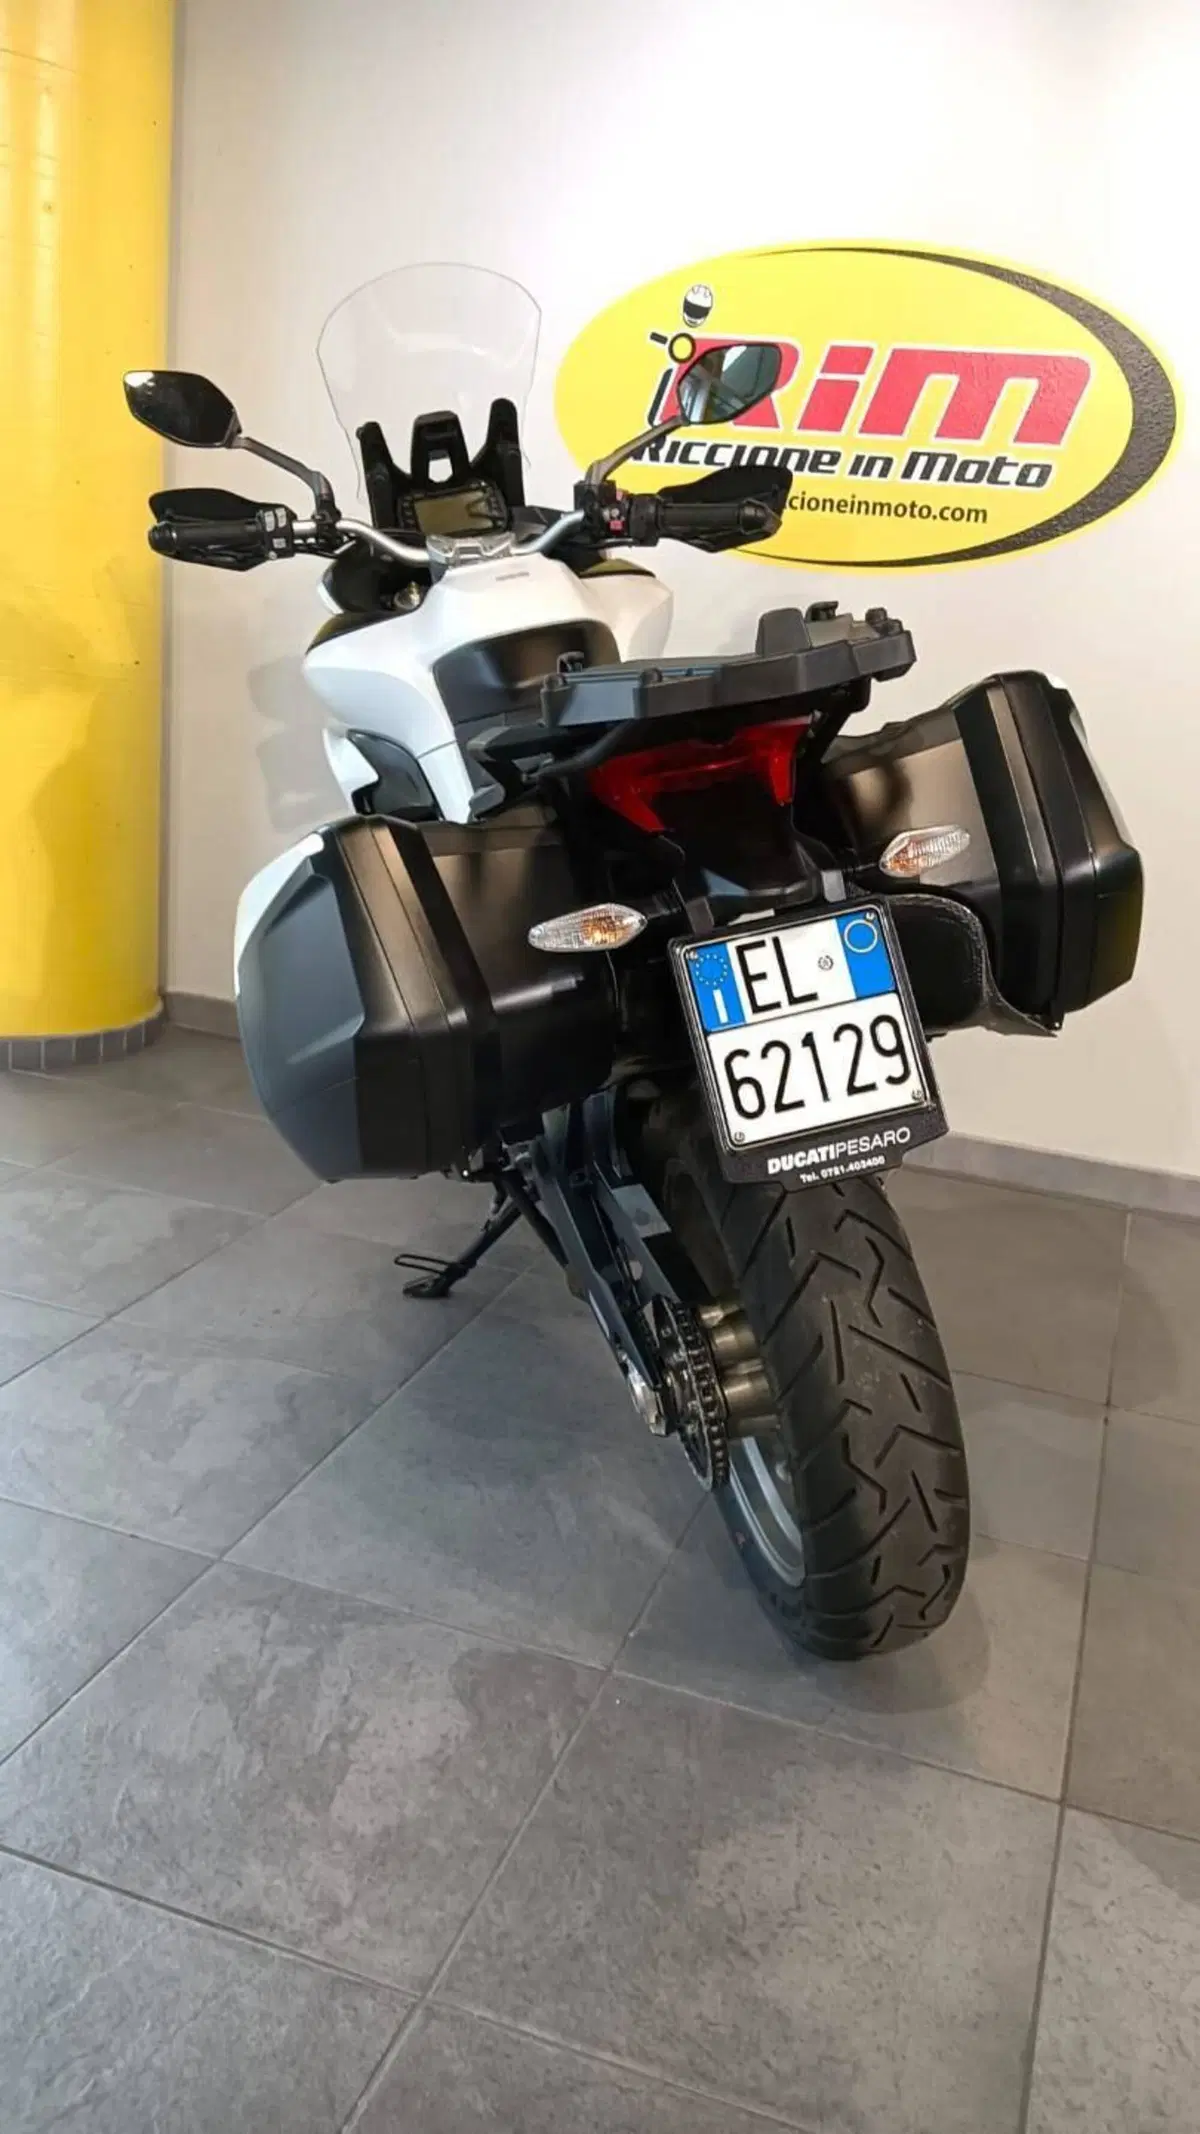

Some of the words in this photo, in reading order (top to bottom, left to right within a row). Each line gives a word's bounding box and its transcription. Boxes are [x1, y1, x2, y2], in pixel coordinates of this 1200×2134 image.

[848, 454, 893, 478] in
[901, 451, 1052, 488] Moto
[783, 491, 987, 523] cioneinmoto.com
[735, 936, 818, 1014] EL
[724, 1014, 911, 1119] 62129
